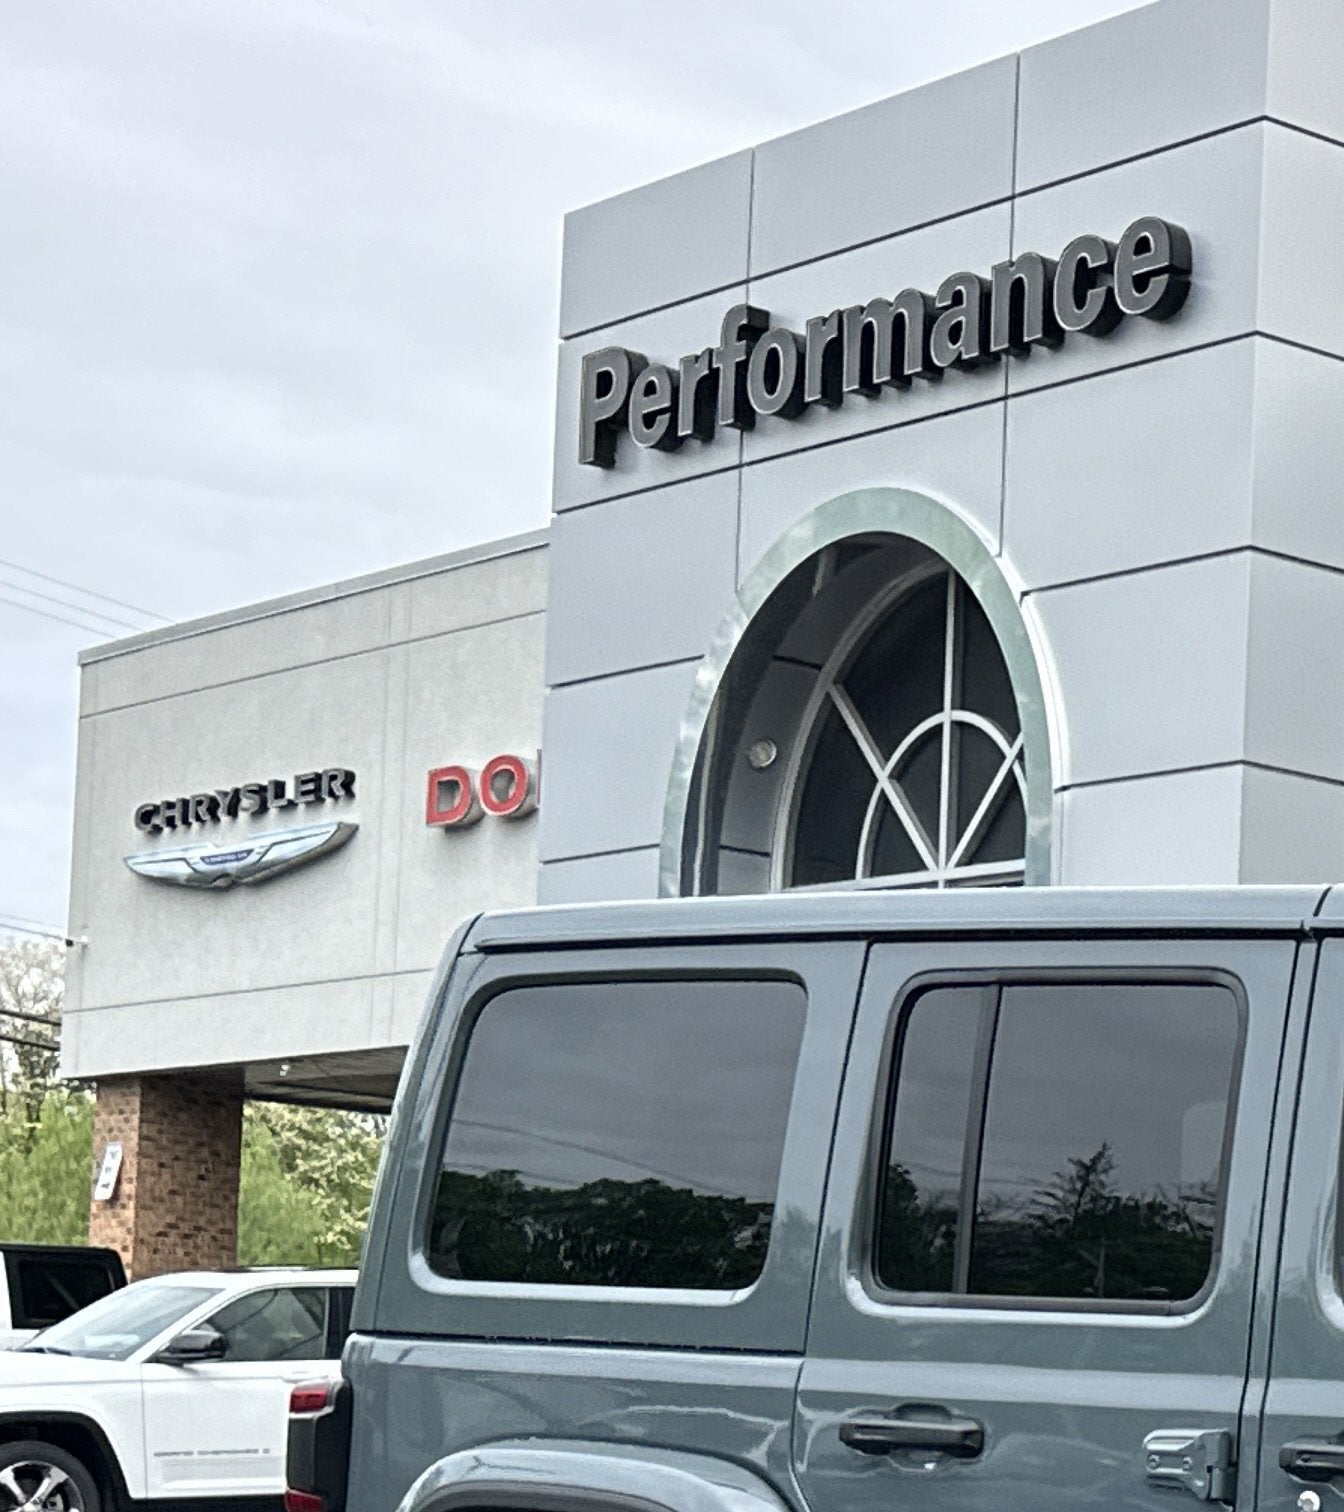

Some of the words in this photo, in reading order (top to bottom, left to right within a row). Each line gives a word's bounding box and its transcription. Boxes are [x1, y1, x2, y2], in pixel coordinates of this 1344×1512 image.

[578, 216, 1192, 469] Performance
[133, 767, 357, 833] CHRYSLER
[426, 748, 542, 829] DO
